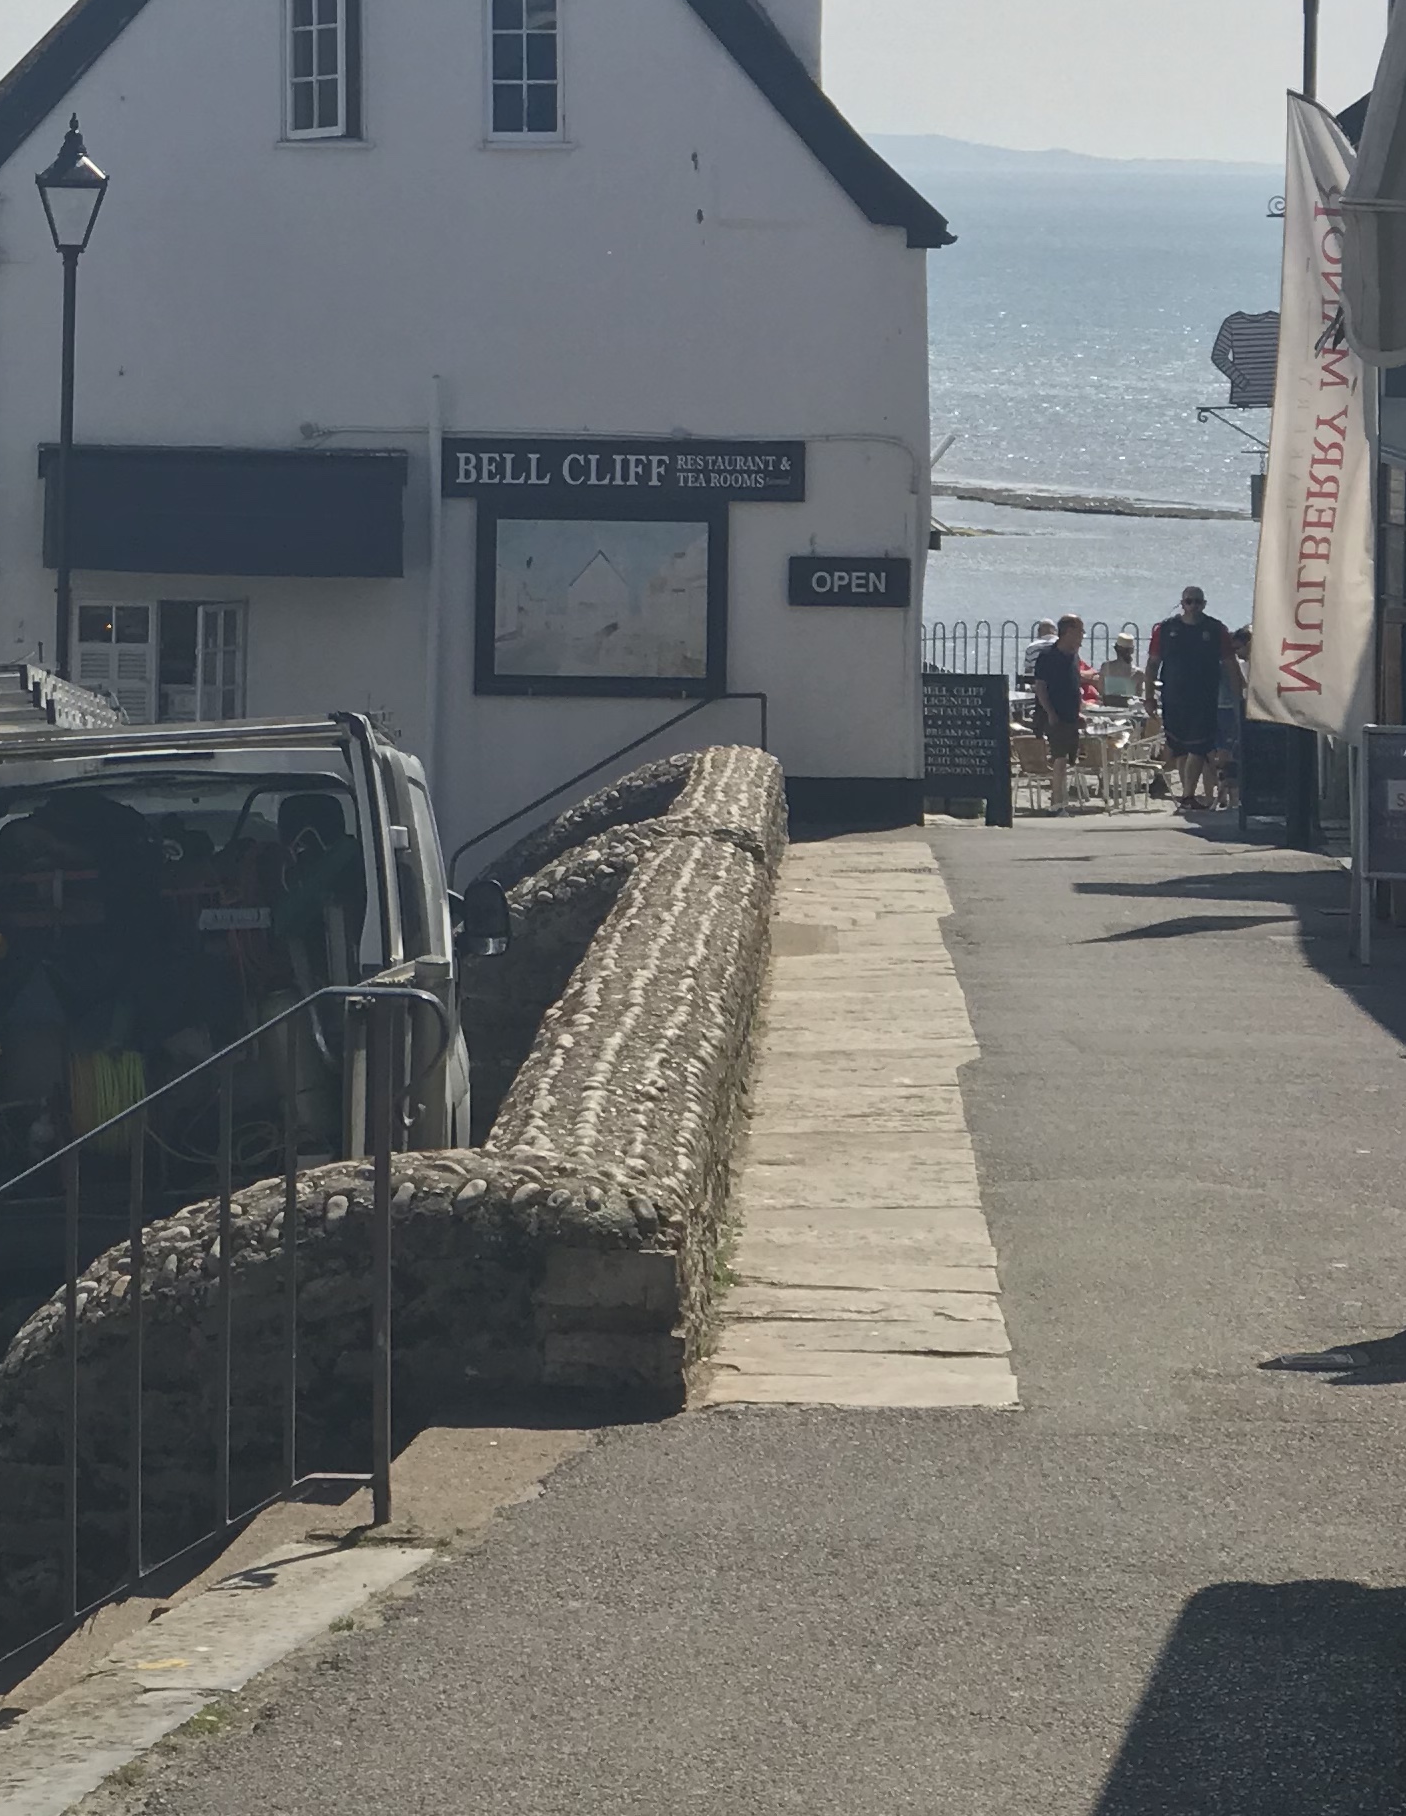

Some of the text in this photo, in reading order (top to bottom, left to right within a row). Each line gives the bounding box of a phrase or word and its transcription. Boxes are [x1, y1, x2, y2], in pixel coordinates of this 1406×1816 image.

[456, 452, 792, 487] BELL CLIFF RESTAURANT &
[677, 472, 707, 487] TEA
[710, 472, 765, 488] ROOMS
[812, 571, 886, 593] OPEN
[953, 686, 986, 696] CLIFF
[924, 707, 993, 717] ESTAURANT
